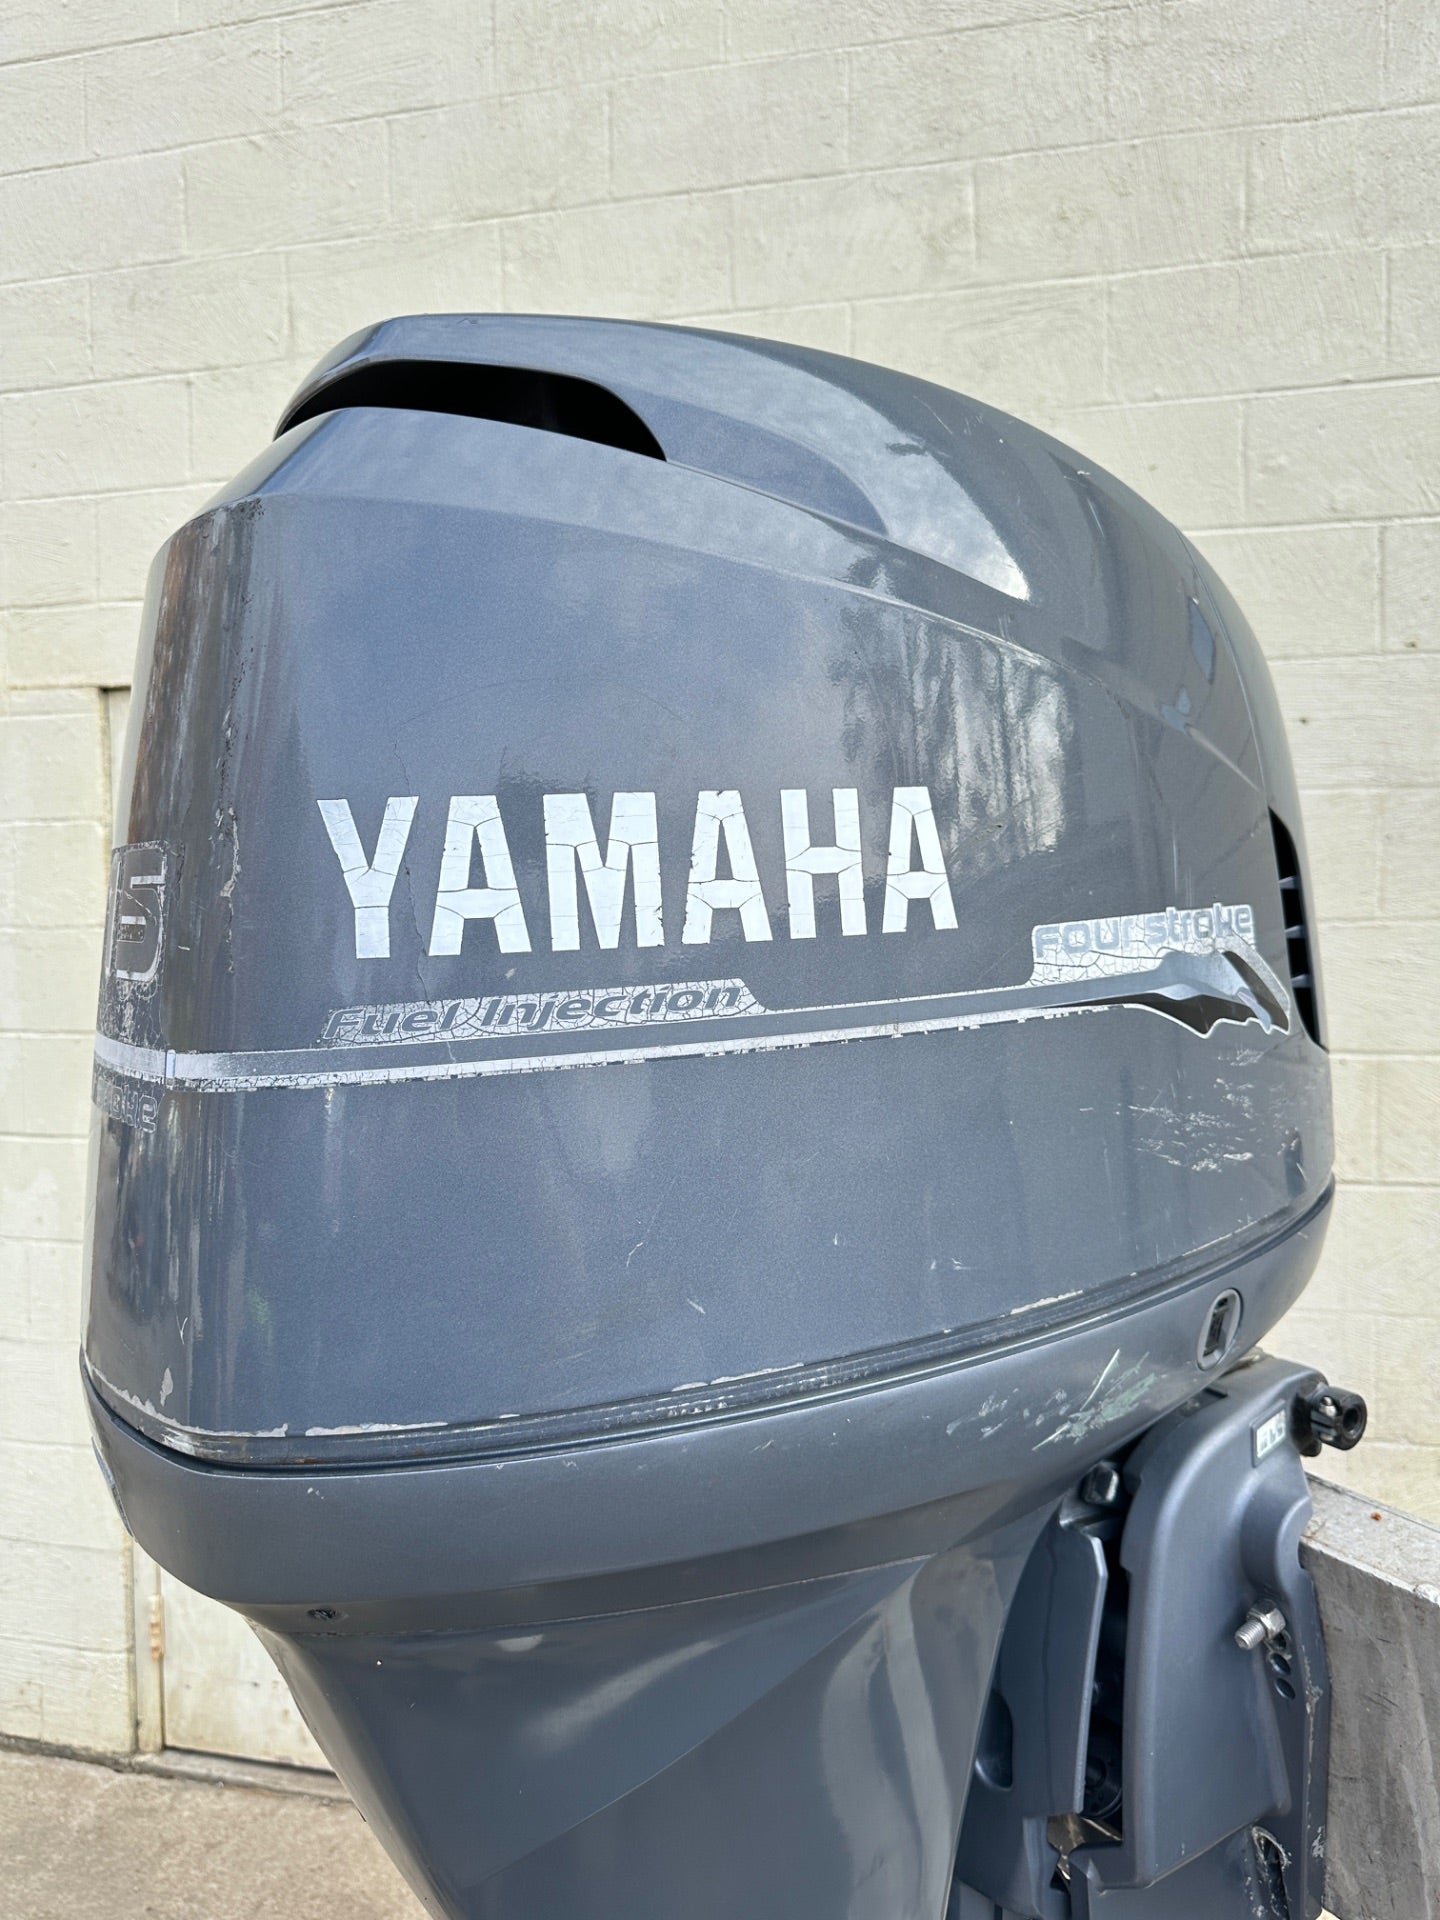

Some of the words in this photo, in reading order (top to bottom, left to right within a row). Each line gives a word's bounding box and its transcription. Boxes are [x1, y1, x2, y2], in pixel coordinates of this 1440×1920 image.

[317, 786, 959, 960] YAMAHA
[325, 1001, 460, 1038] Fuel
[481, 985, 743, 1032] Injection
